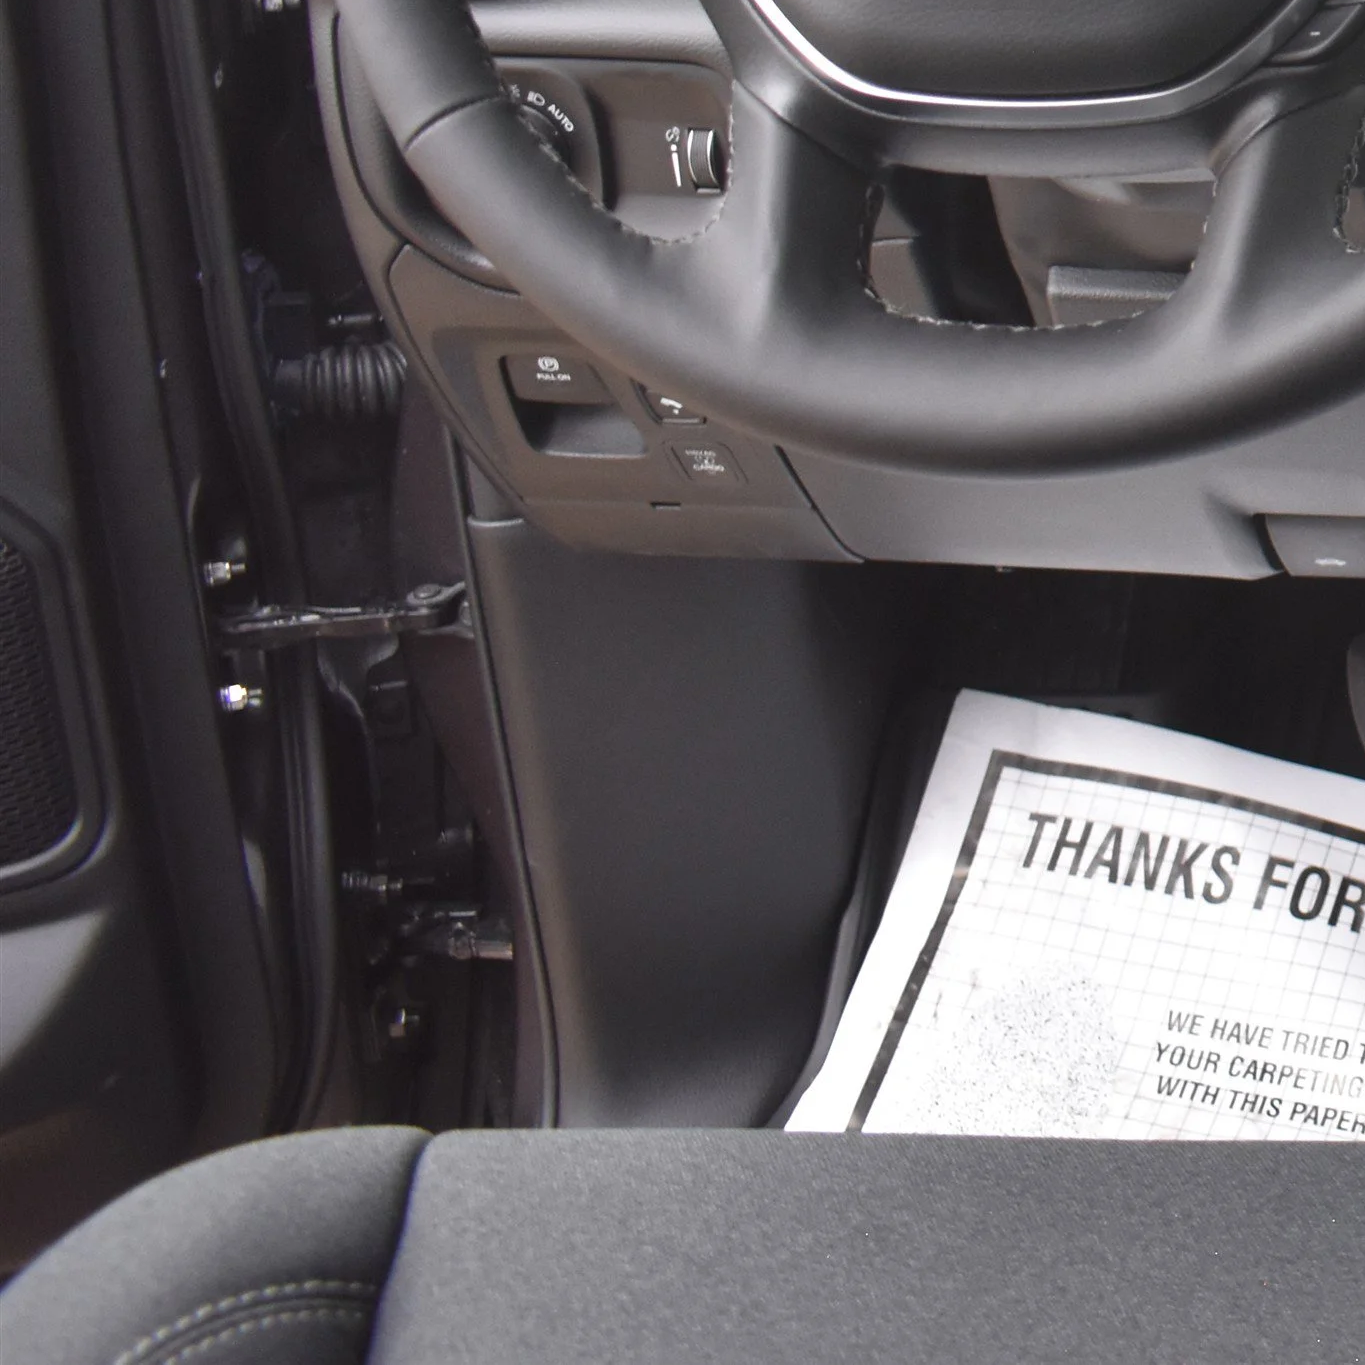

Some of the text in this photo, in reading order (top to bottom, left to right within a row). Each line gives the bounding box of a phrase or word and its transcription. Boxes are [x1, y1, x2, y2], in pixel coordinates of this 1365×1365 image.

[547, 104, 575, 133] AUTO
[1021, 811, 1242, 905] THANKS
[1167, 1010, 1205, 1036] WE
[1210, 1017, 1273, 1049] HAVE
[1282, 1029, 1350, 1061] TRIED
[1155, 1041, 1221, 1073] YOUR
[1228, 1055, 1364, 1098] CARPETING
[1156, 1075, 1221, 1105] WITH
[1228, 1089, 1284, 1118] THIS
